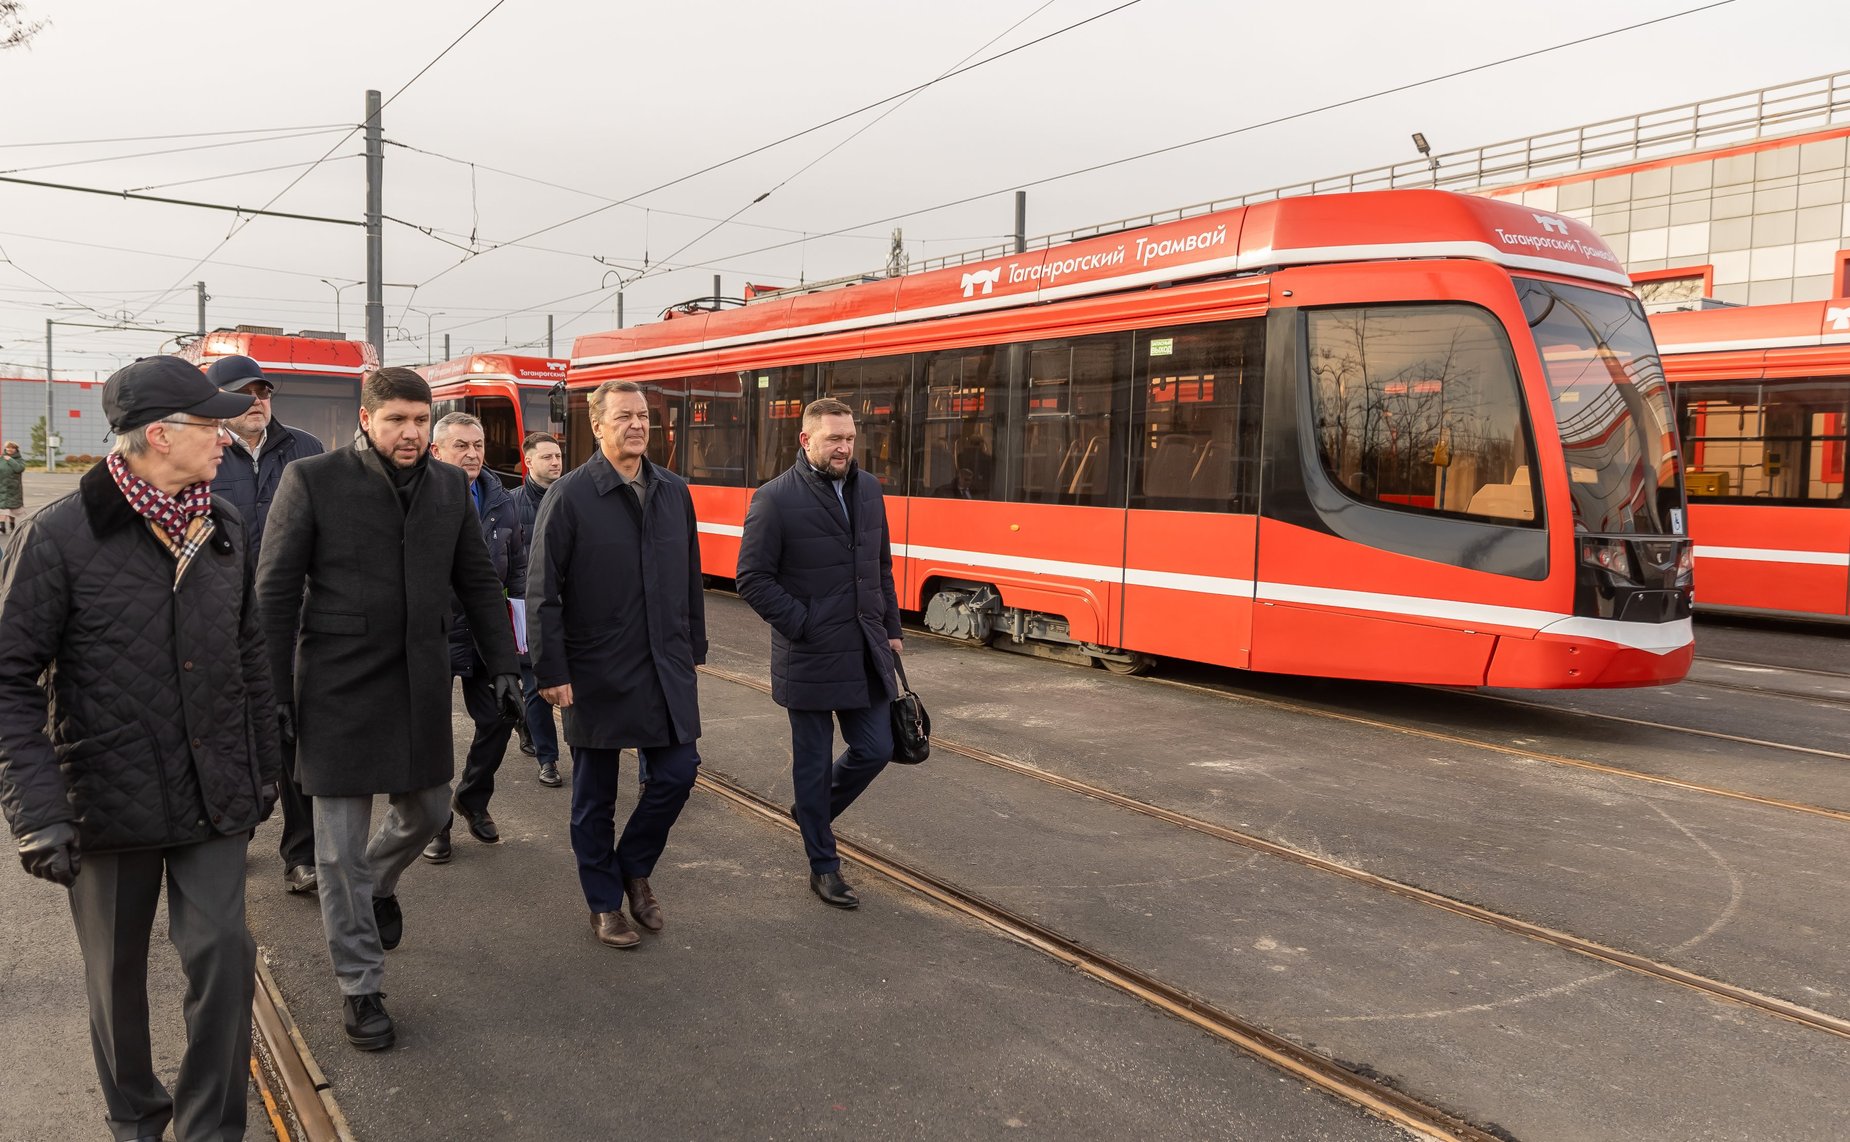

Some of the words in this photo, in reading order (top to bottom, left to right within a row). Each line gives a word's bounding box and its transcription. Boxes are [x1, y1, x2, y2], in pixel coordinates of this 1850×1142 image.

[1495, 228, 1577, 252] Таганрогский
[1008, 245, 1125, 284] Таганрогский
[1135, 224, 1226, 266] Трамвай
[519, 368, 566, 379] Таганрогский
